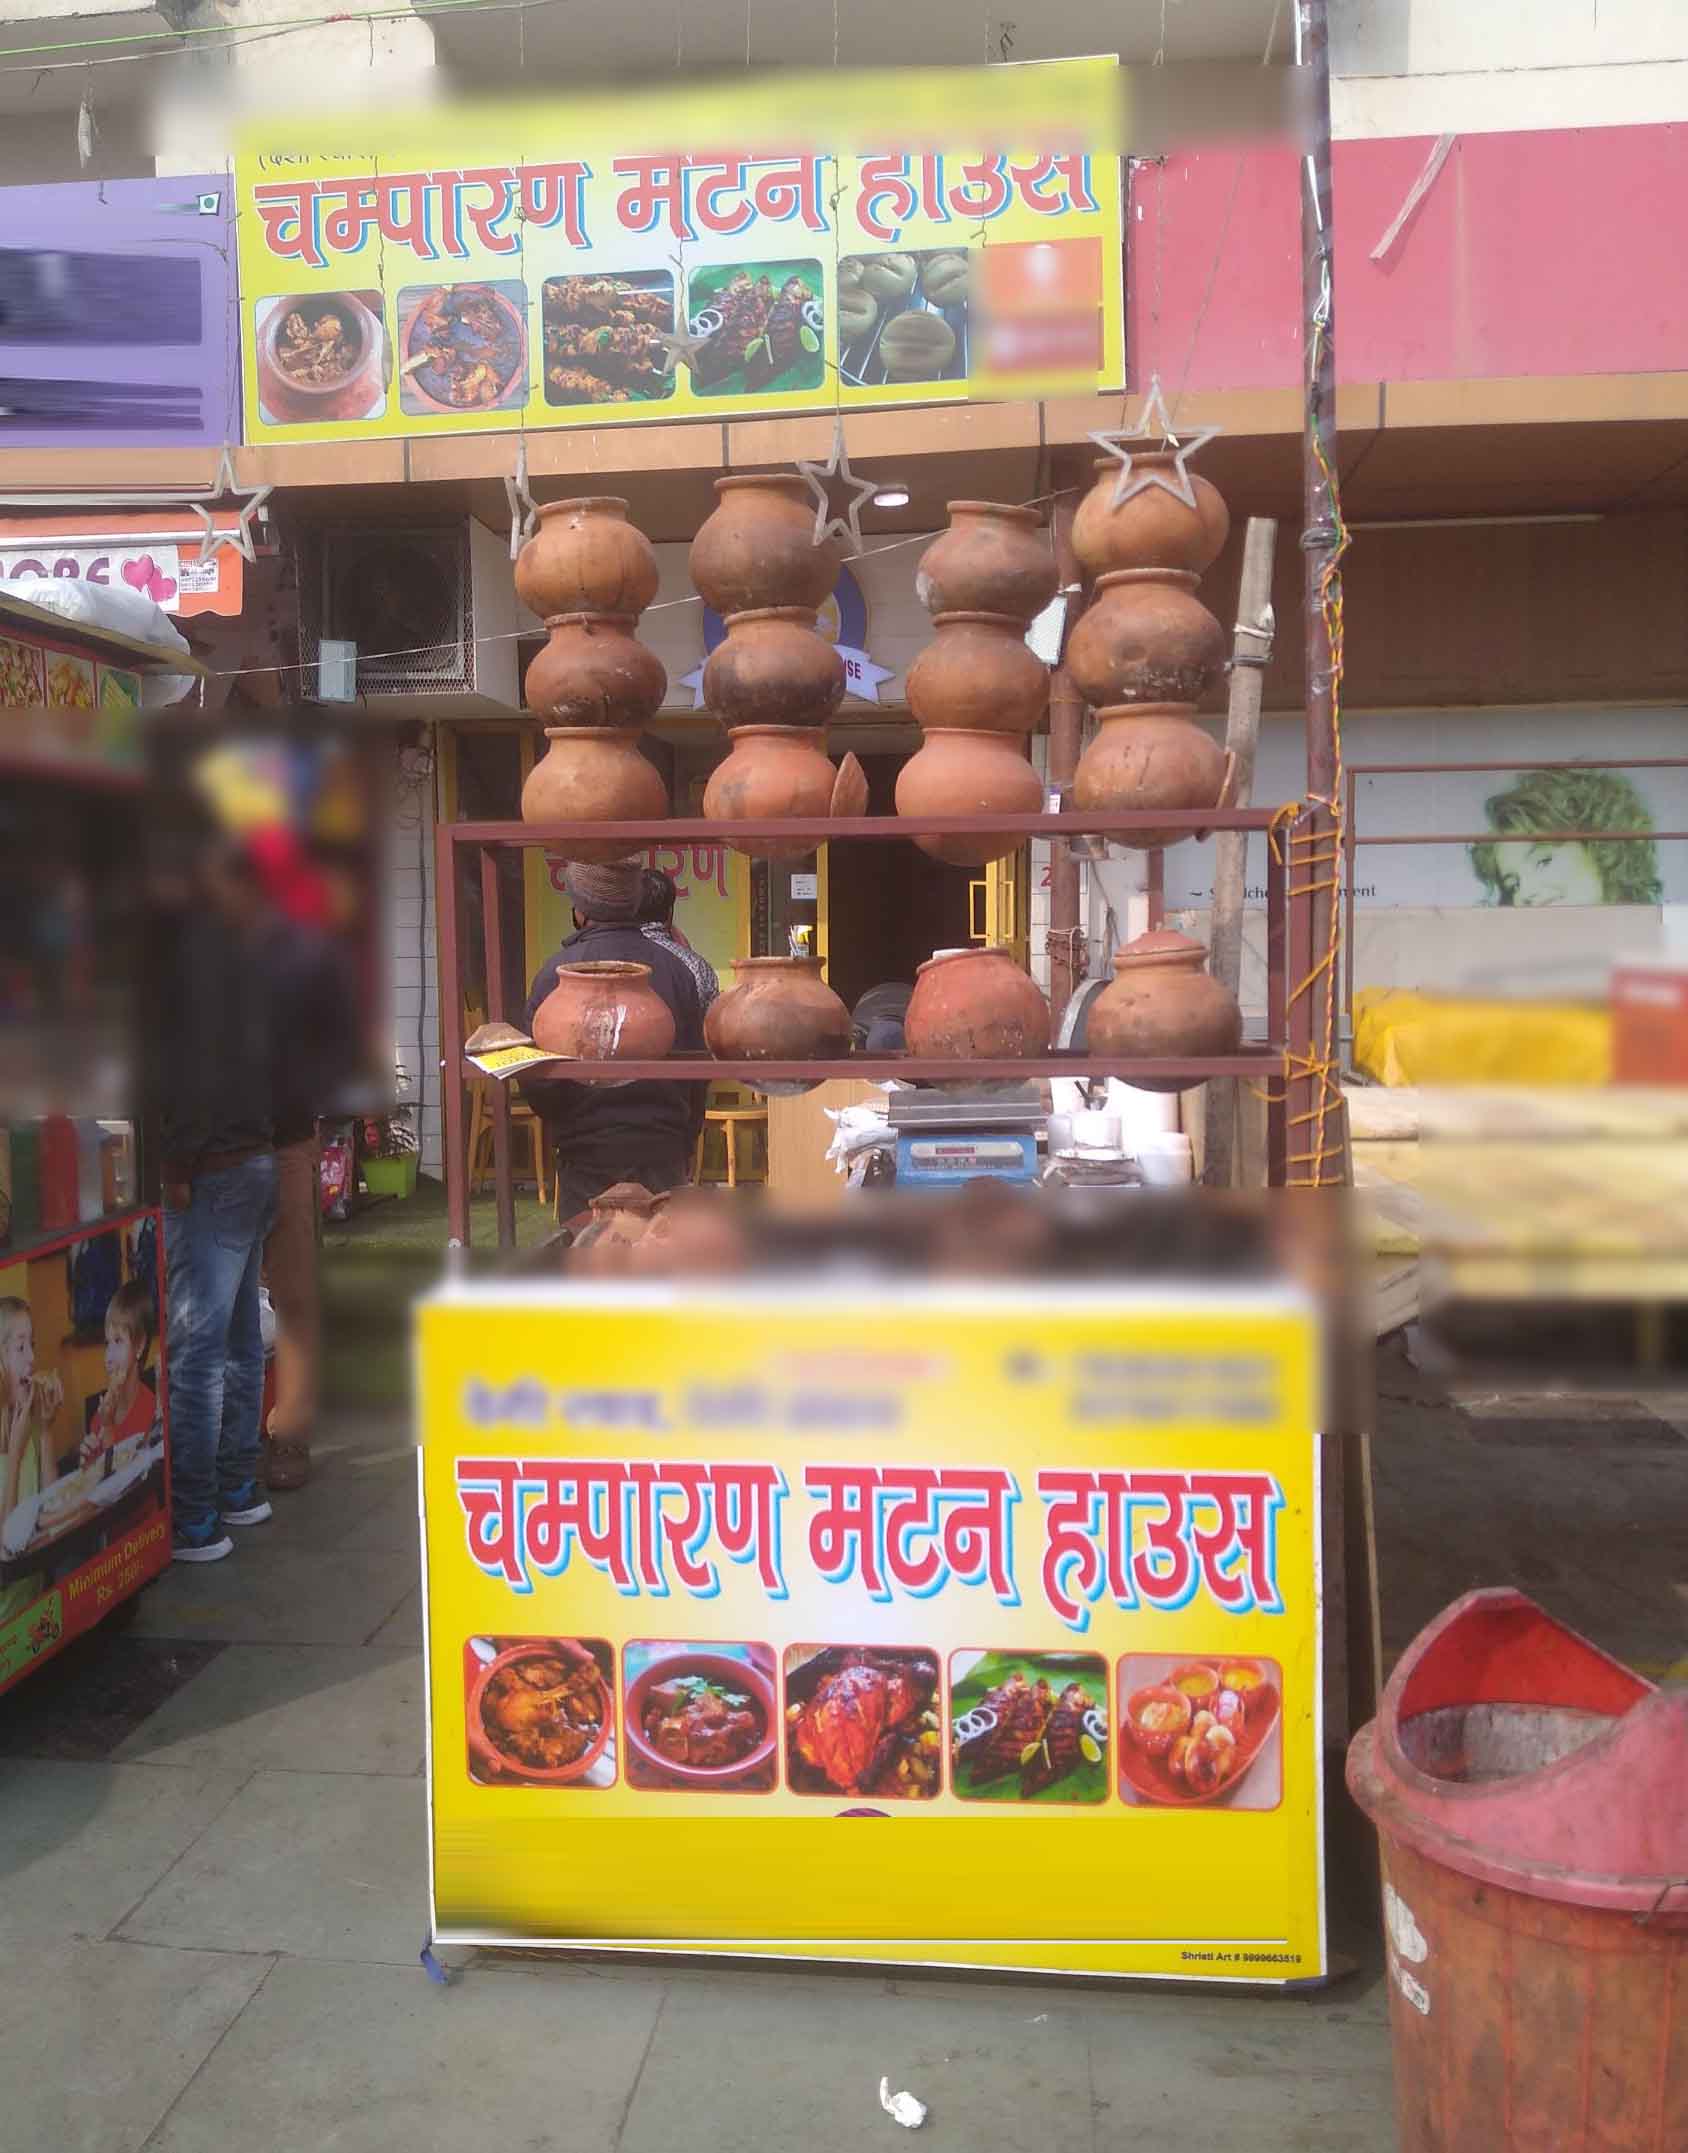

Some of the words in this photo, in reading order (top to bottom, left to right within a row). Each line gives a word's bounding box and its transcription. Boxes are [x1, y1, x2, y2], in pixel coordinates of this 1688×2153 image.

[254, 161, 593, 268] चम्पारण
[612, 153, 831, 243] मटन
[855, 153, 1101, 243] हाउस
[456, 1459, 790, 1600] चम्पारण
[803, 1465, 1023, 1608] मटन
[1036, 1469, 1287, 1633] हाउस
[1215, 1952, 1233, 1962] Art
